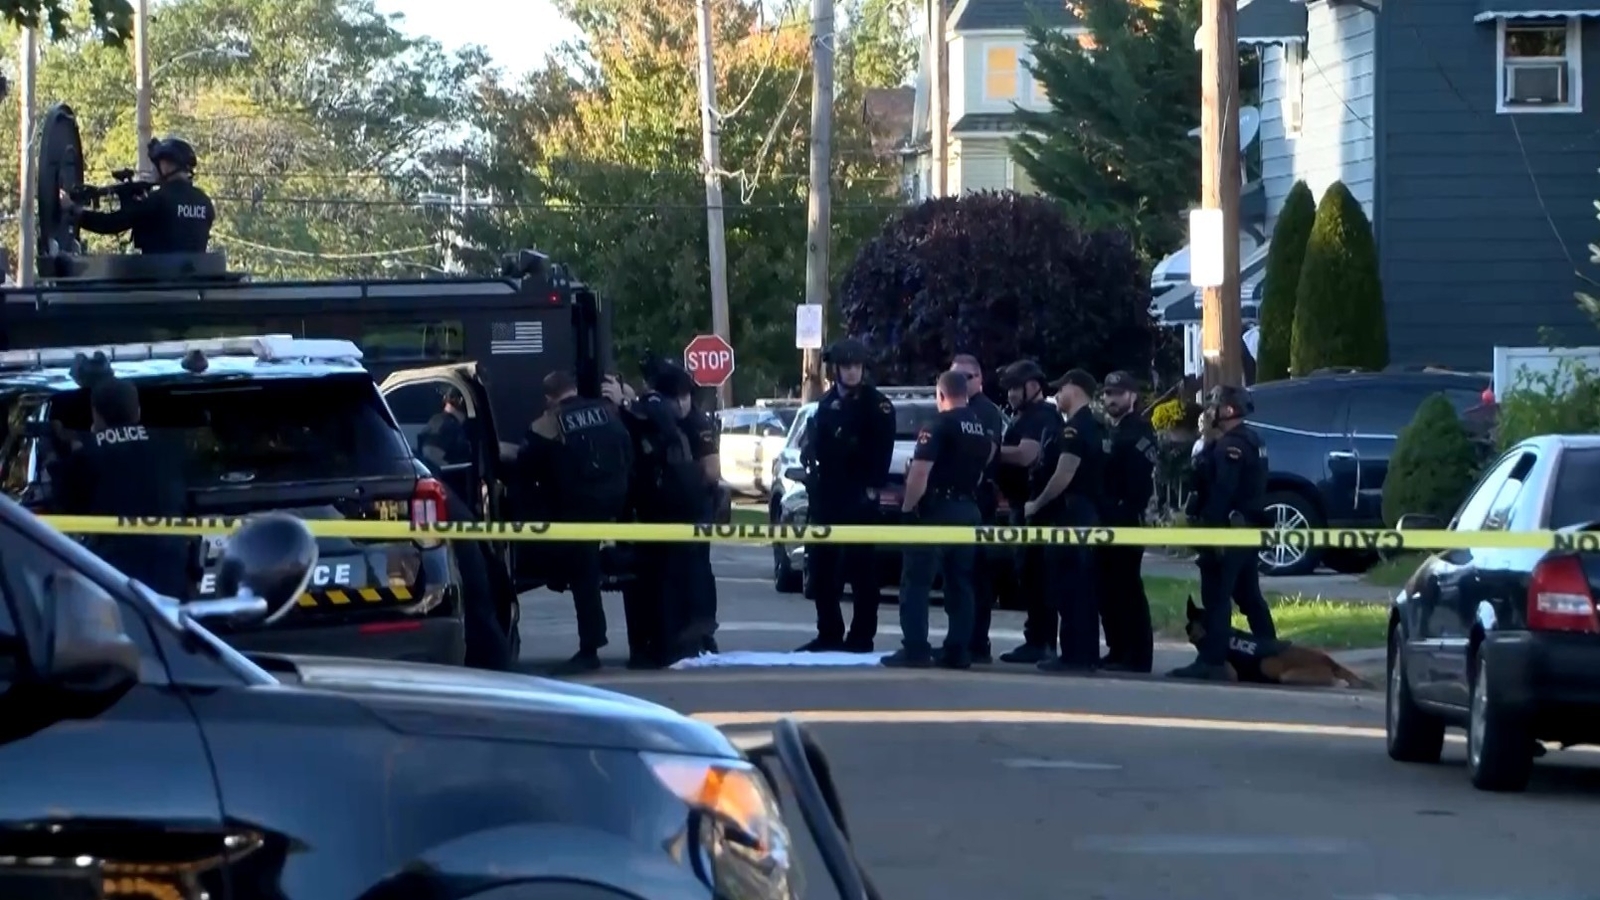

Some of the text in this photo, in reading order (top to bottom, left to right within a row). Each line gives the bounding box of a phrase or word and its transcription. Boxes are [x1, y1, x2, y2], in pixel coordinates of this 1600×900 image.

[177, 204, 206, 219] POLICE
[688, 350, 730, 370] STOP
[96, 425, 149, 446] POLICE
[693, 524, 832, 539] CAUTION
[975, 527, 1115, 545] CAUTION
[1260, 530, 1404, 549] CAUTION
[1229, 637, 1257, 656] LICE
